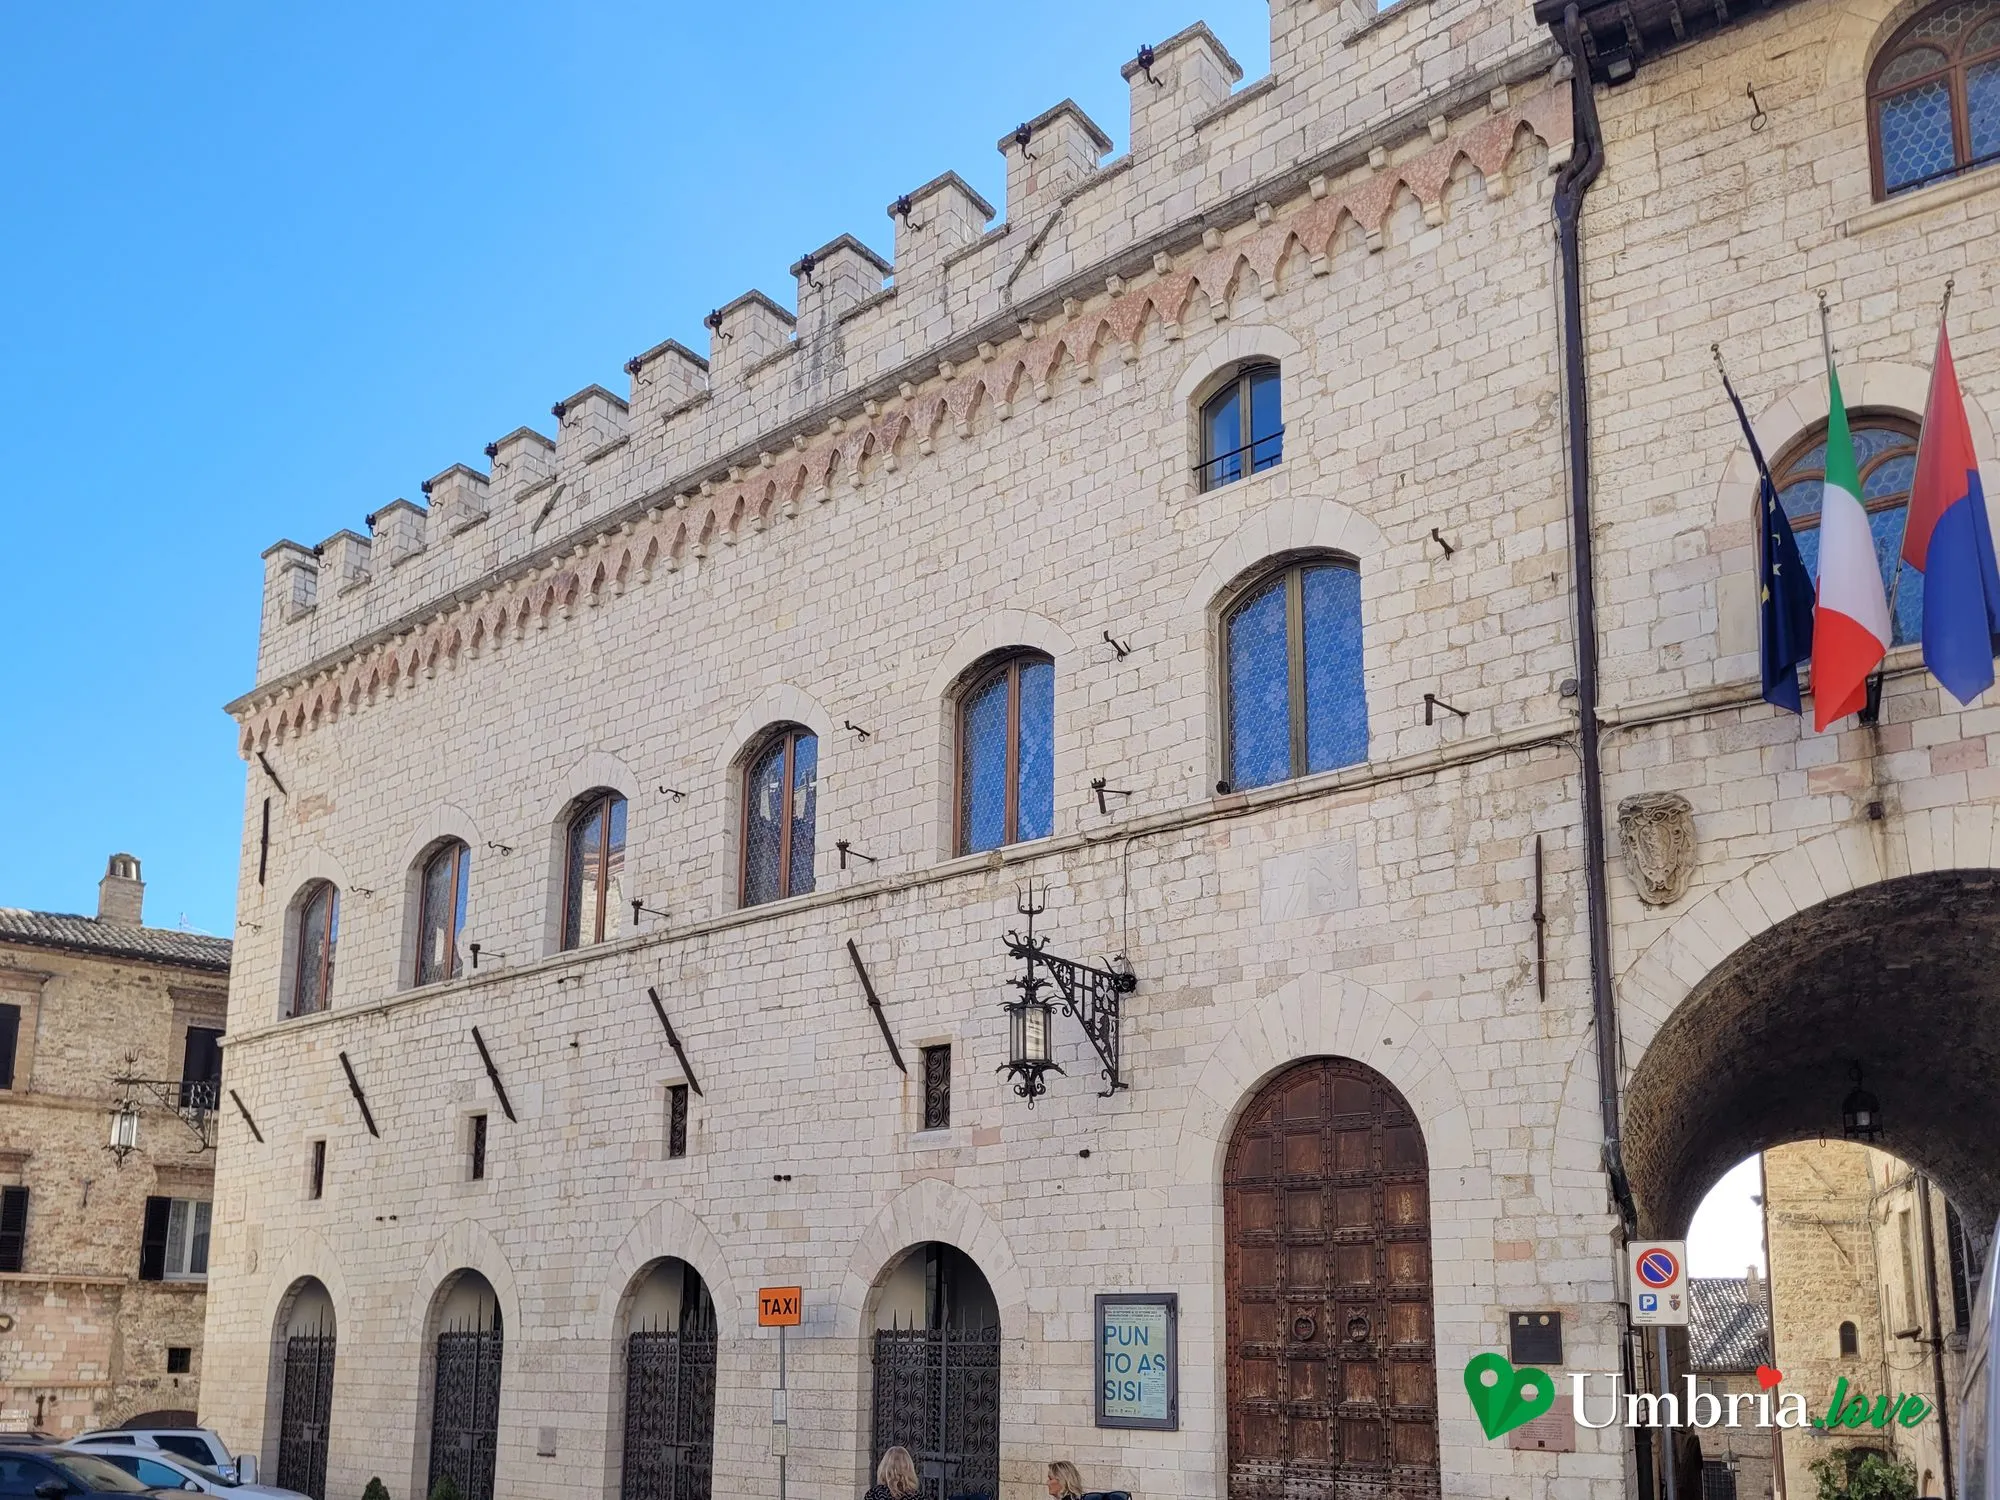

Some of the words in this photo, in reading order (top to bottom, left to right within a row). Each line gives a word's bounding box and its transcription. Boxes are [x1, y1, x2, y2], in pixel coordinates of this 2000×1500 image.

[1460, 1176, 1466, 1186] 5
[762, 1297, 798, 1316] TAXI
[1642, 1295, 1655, 1310] P
[1104, 1325, 1149, 1346] PUN
[1104, 1352, 1132, 1374] TO
[1137, 1353, 1166, 1374] AS
[1104, 1379, 1142, 1402] SISI
